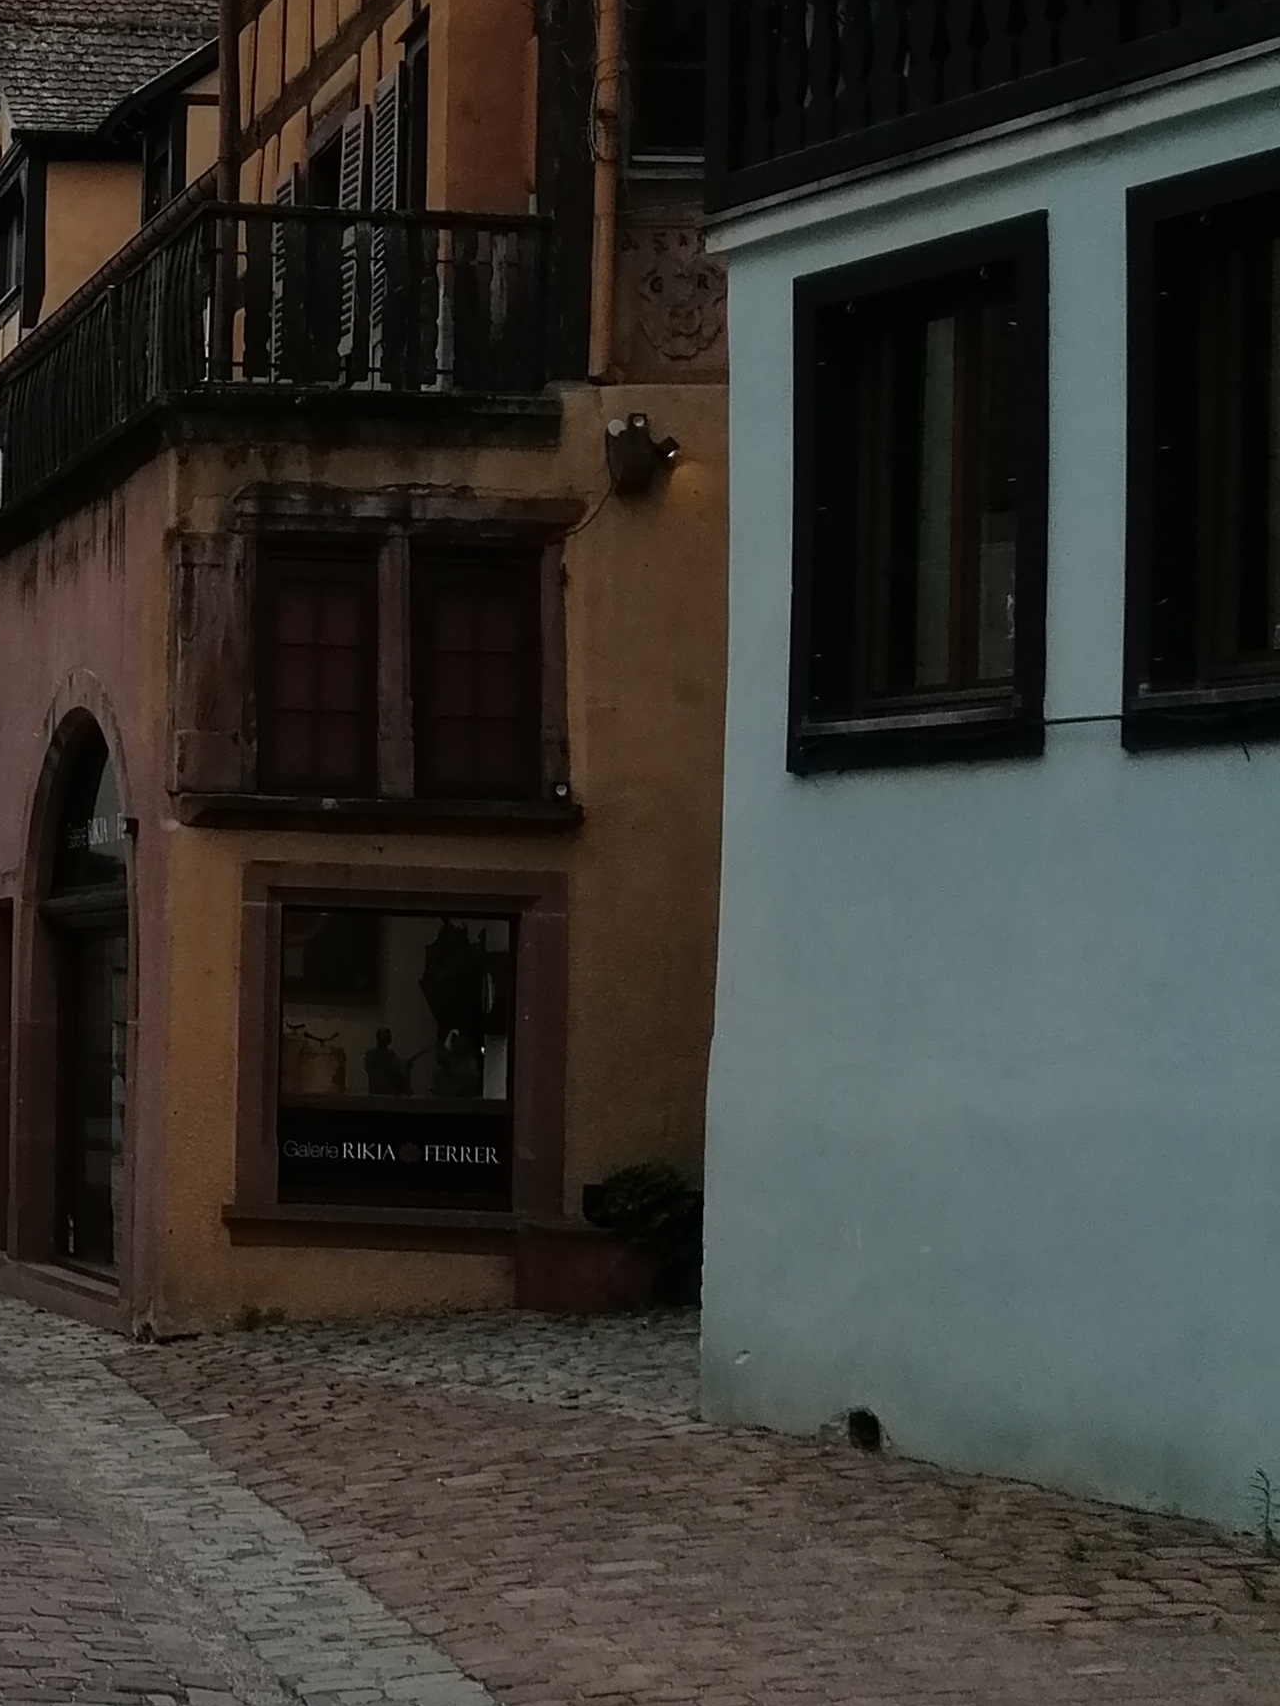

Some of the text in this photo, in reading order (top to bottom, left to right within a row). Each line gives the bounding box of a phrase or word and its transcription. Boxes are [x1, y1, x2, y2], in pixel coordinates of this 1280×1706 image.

[283, 1139, 501, 1164] Galerie RIKIA FERRER
